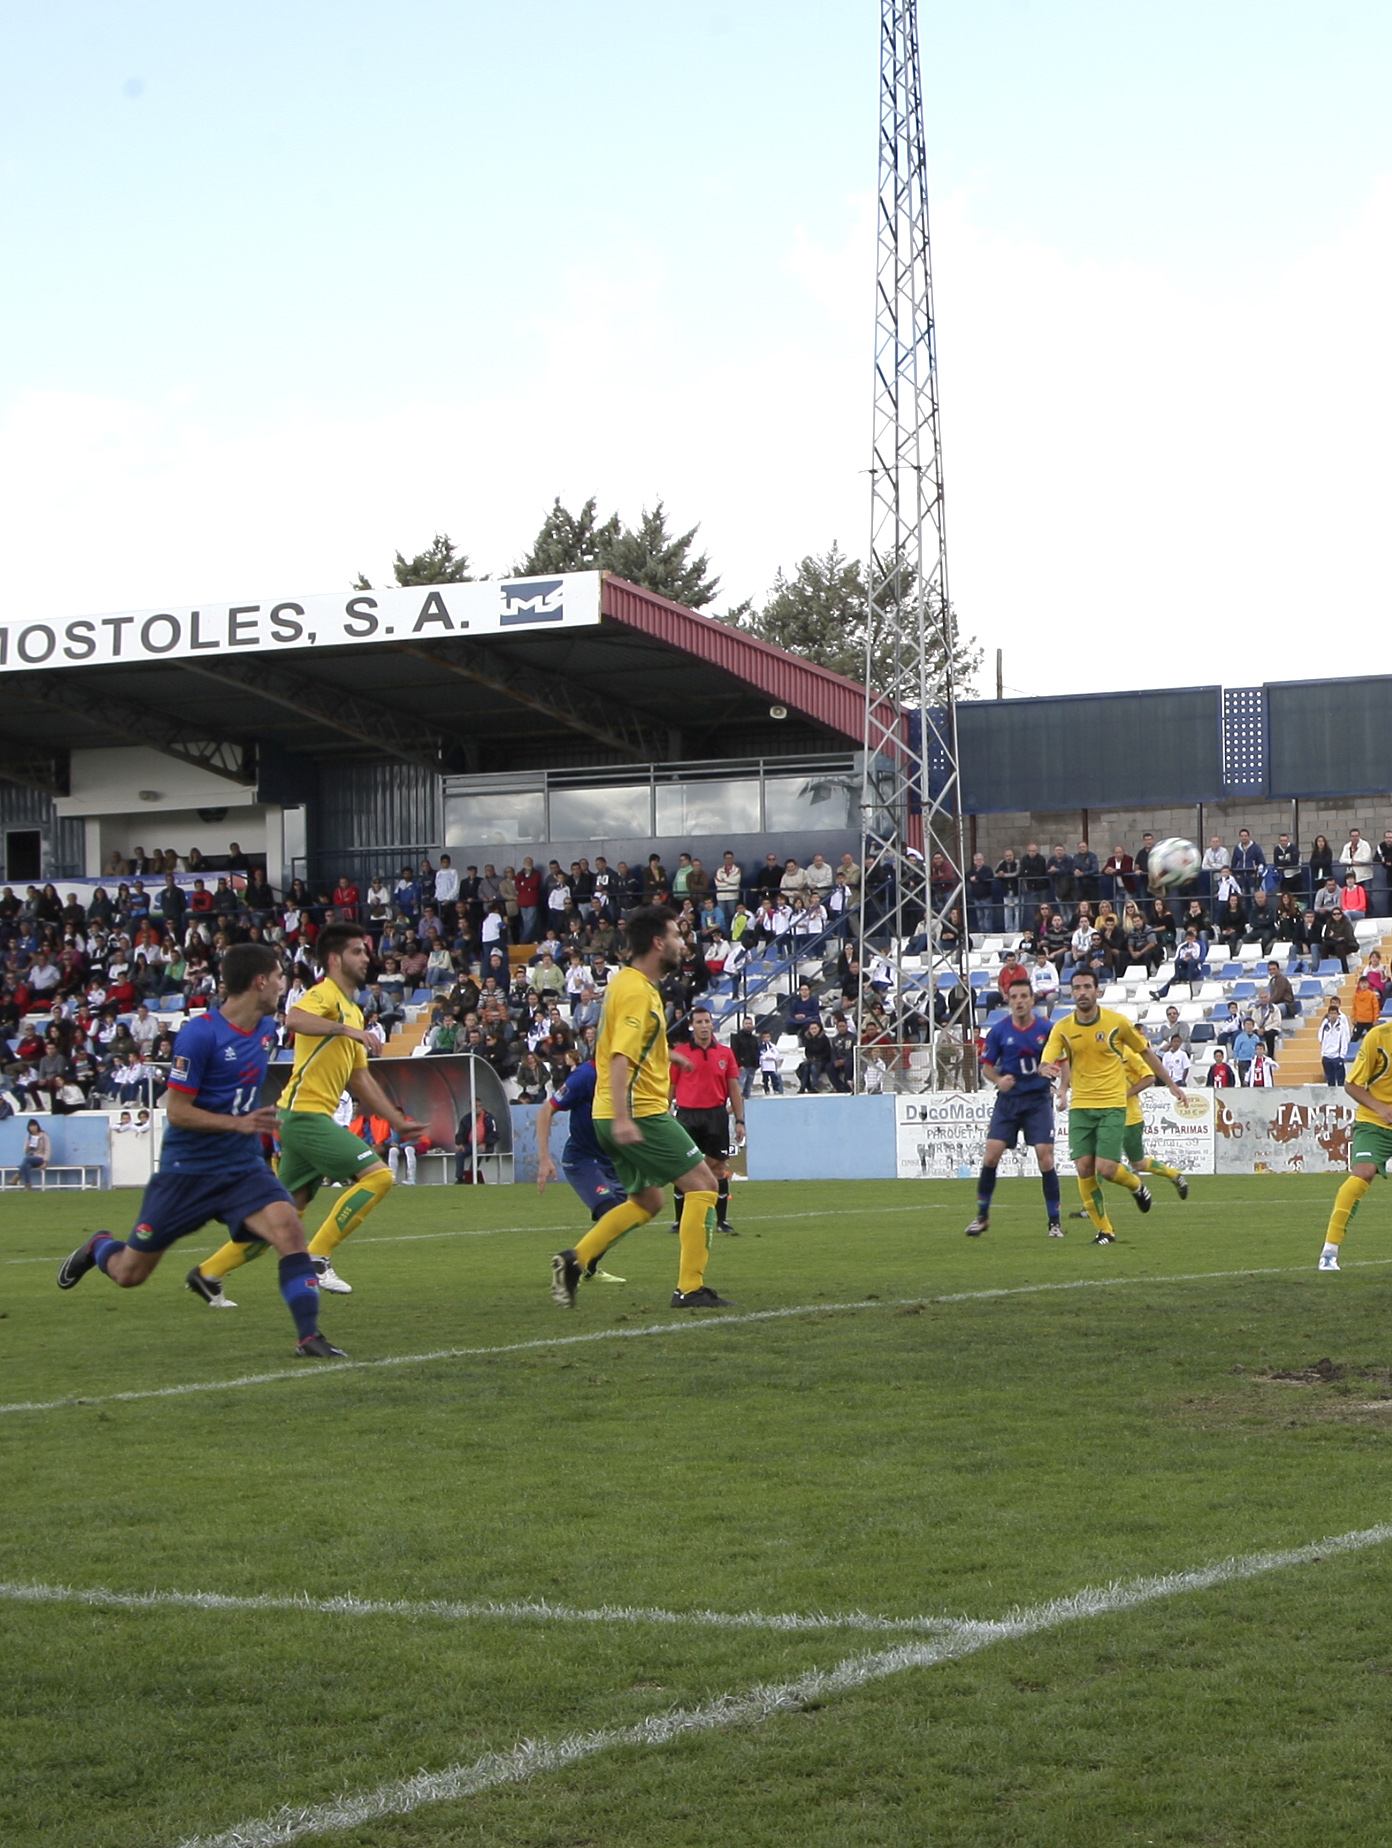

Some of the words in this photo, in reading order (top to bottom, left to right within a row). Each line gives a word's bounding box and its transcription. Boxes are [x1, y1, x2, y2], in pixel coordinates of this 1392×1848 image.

[343, 596, 395, 637] S.
[412, 591, 470, 633] A.
[905, 1104, 994, 1120] DcoMade
[1170, 1125, 1209, 1135] TARIMAS
